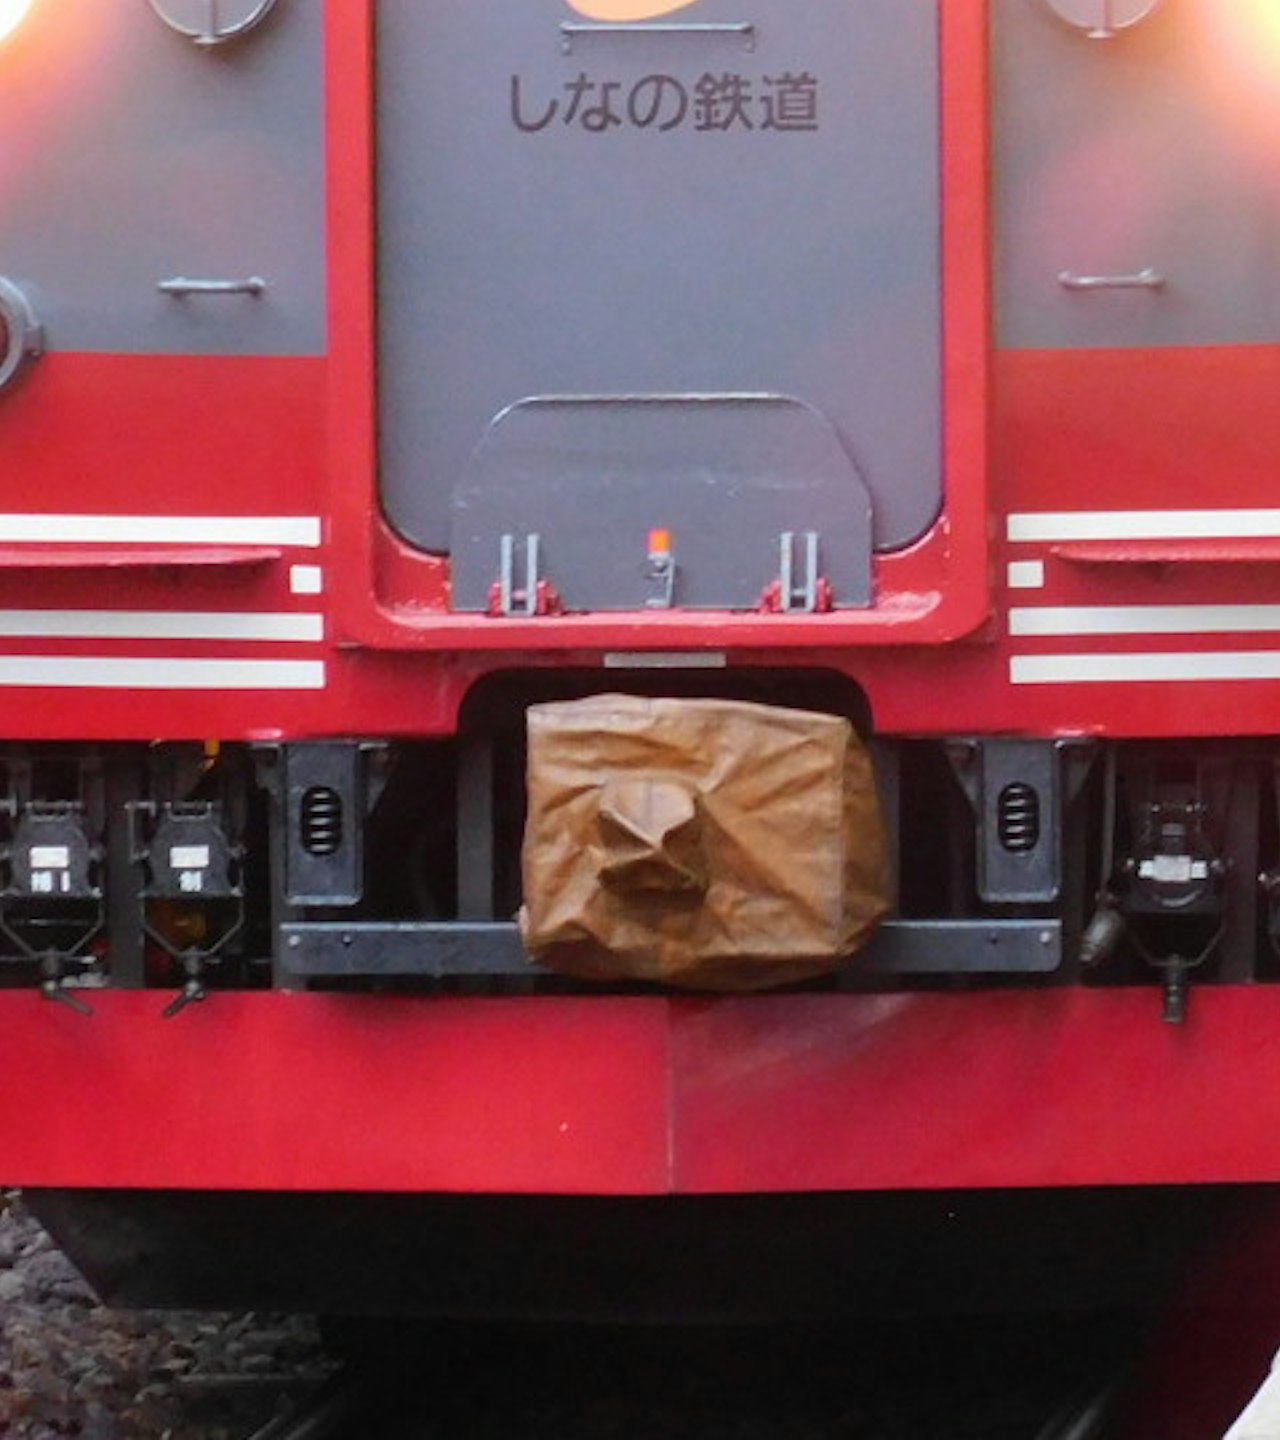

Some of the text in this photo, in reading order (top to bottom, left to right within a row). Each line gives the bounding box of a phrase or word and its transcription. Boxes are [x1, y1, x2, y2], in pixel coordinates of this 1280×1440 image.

[510, 71, 818, 133] しなの鉄道
